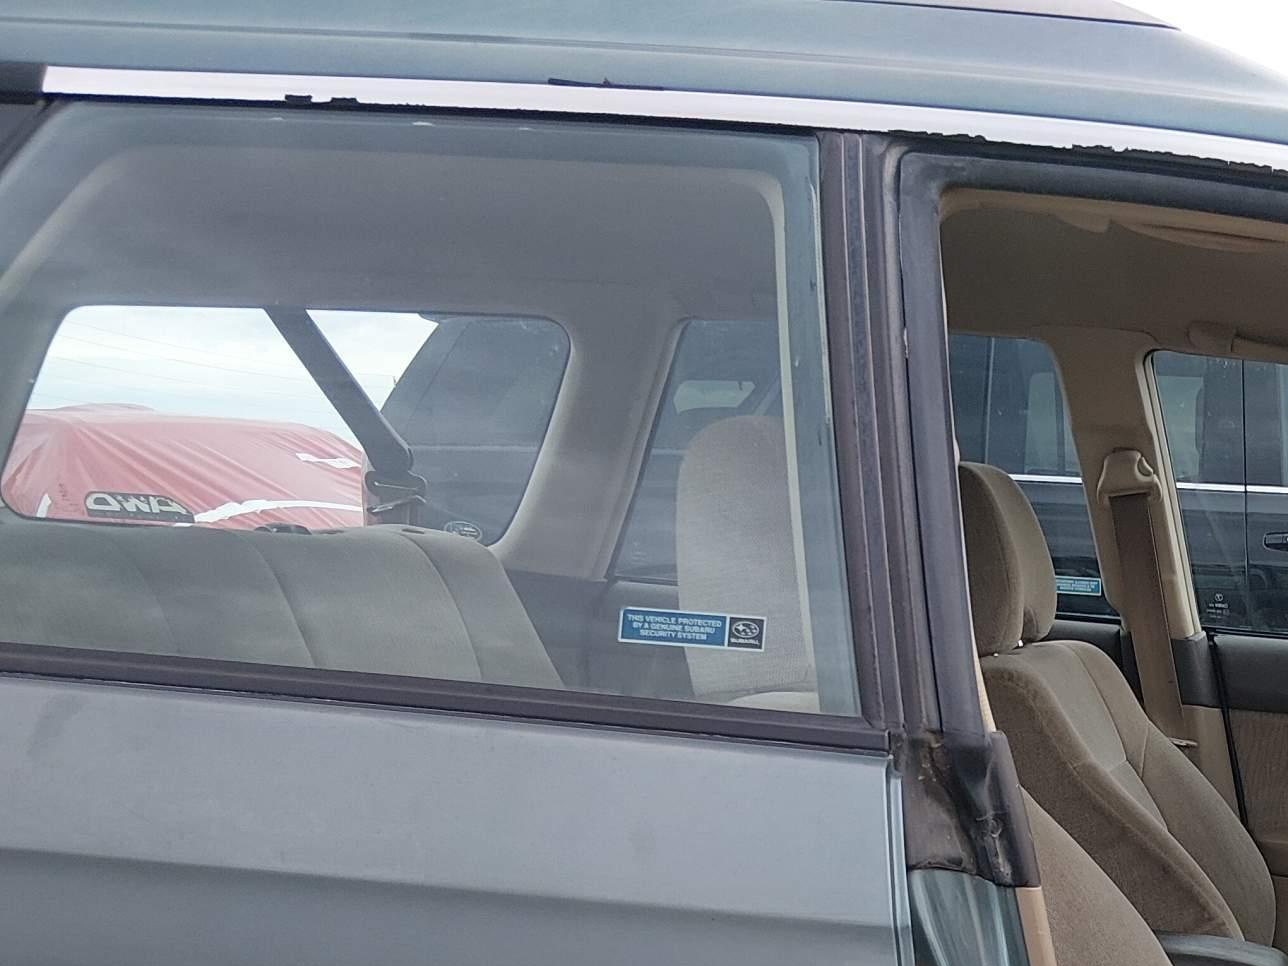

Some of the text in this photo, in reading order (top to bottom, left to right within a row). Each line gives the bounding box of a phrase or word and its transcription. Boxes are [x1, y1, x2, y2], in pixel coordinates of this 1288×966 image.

[628, 614, 722, 628] THIS VEHICLE PROTECTED
[640, 629, 707, 640] SECURITY SYSTEM
[651, 624, 683, 632] GENUINE
[685, 625, 715, 634] SUBARU
